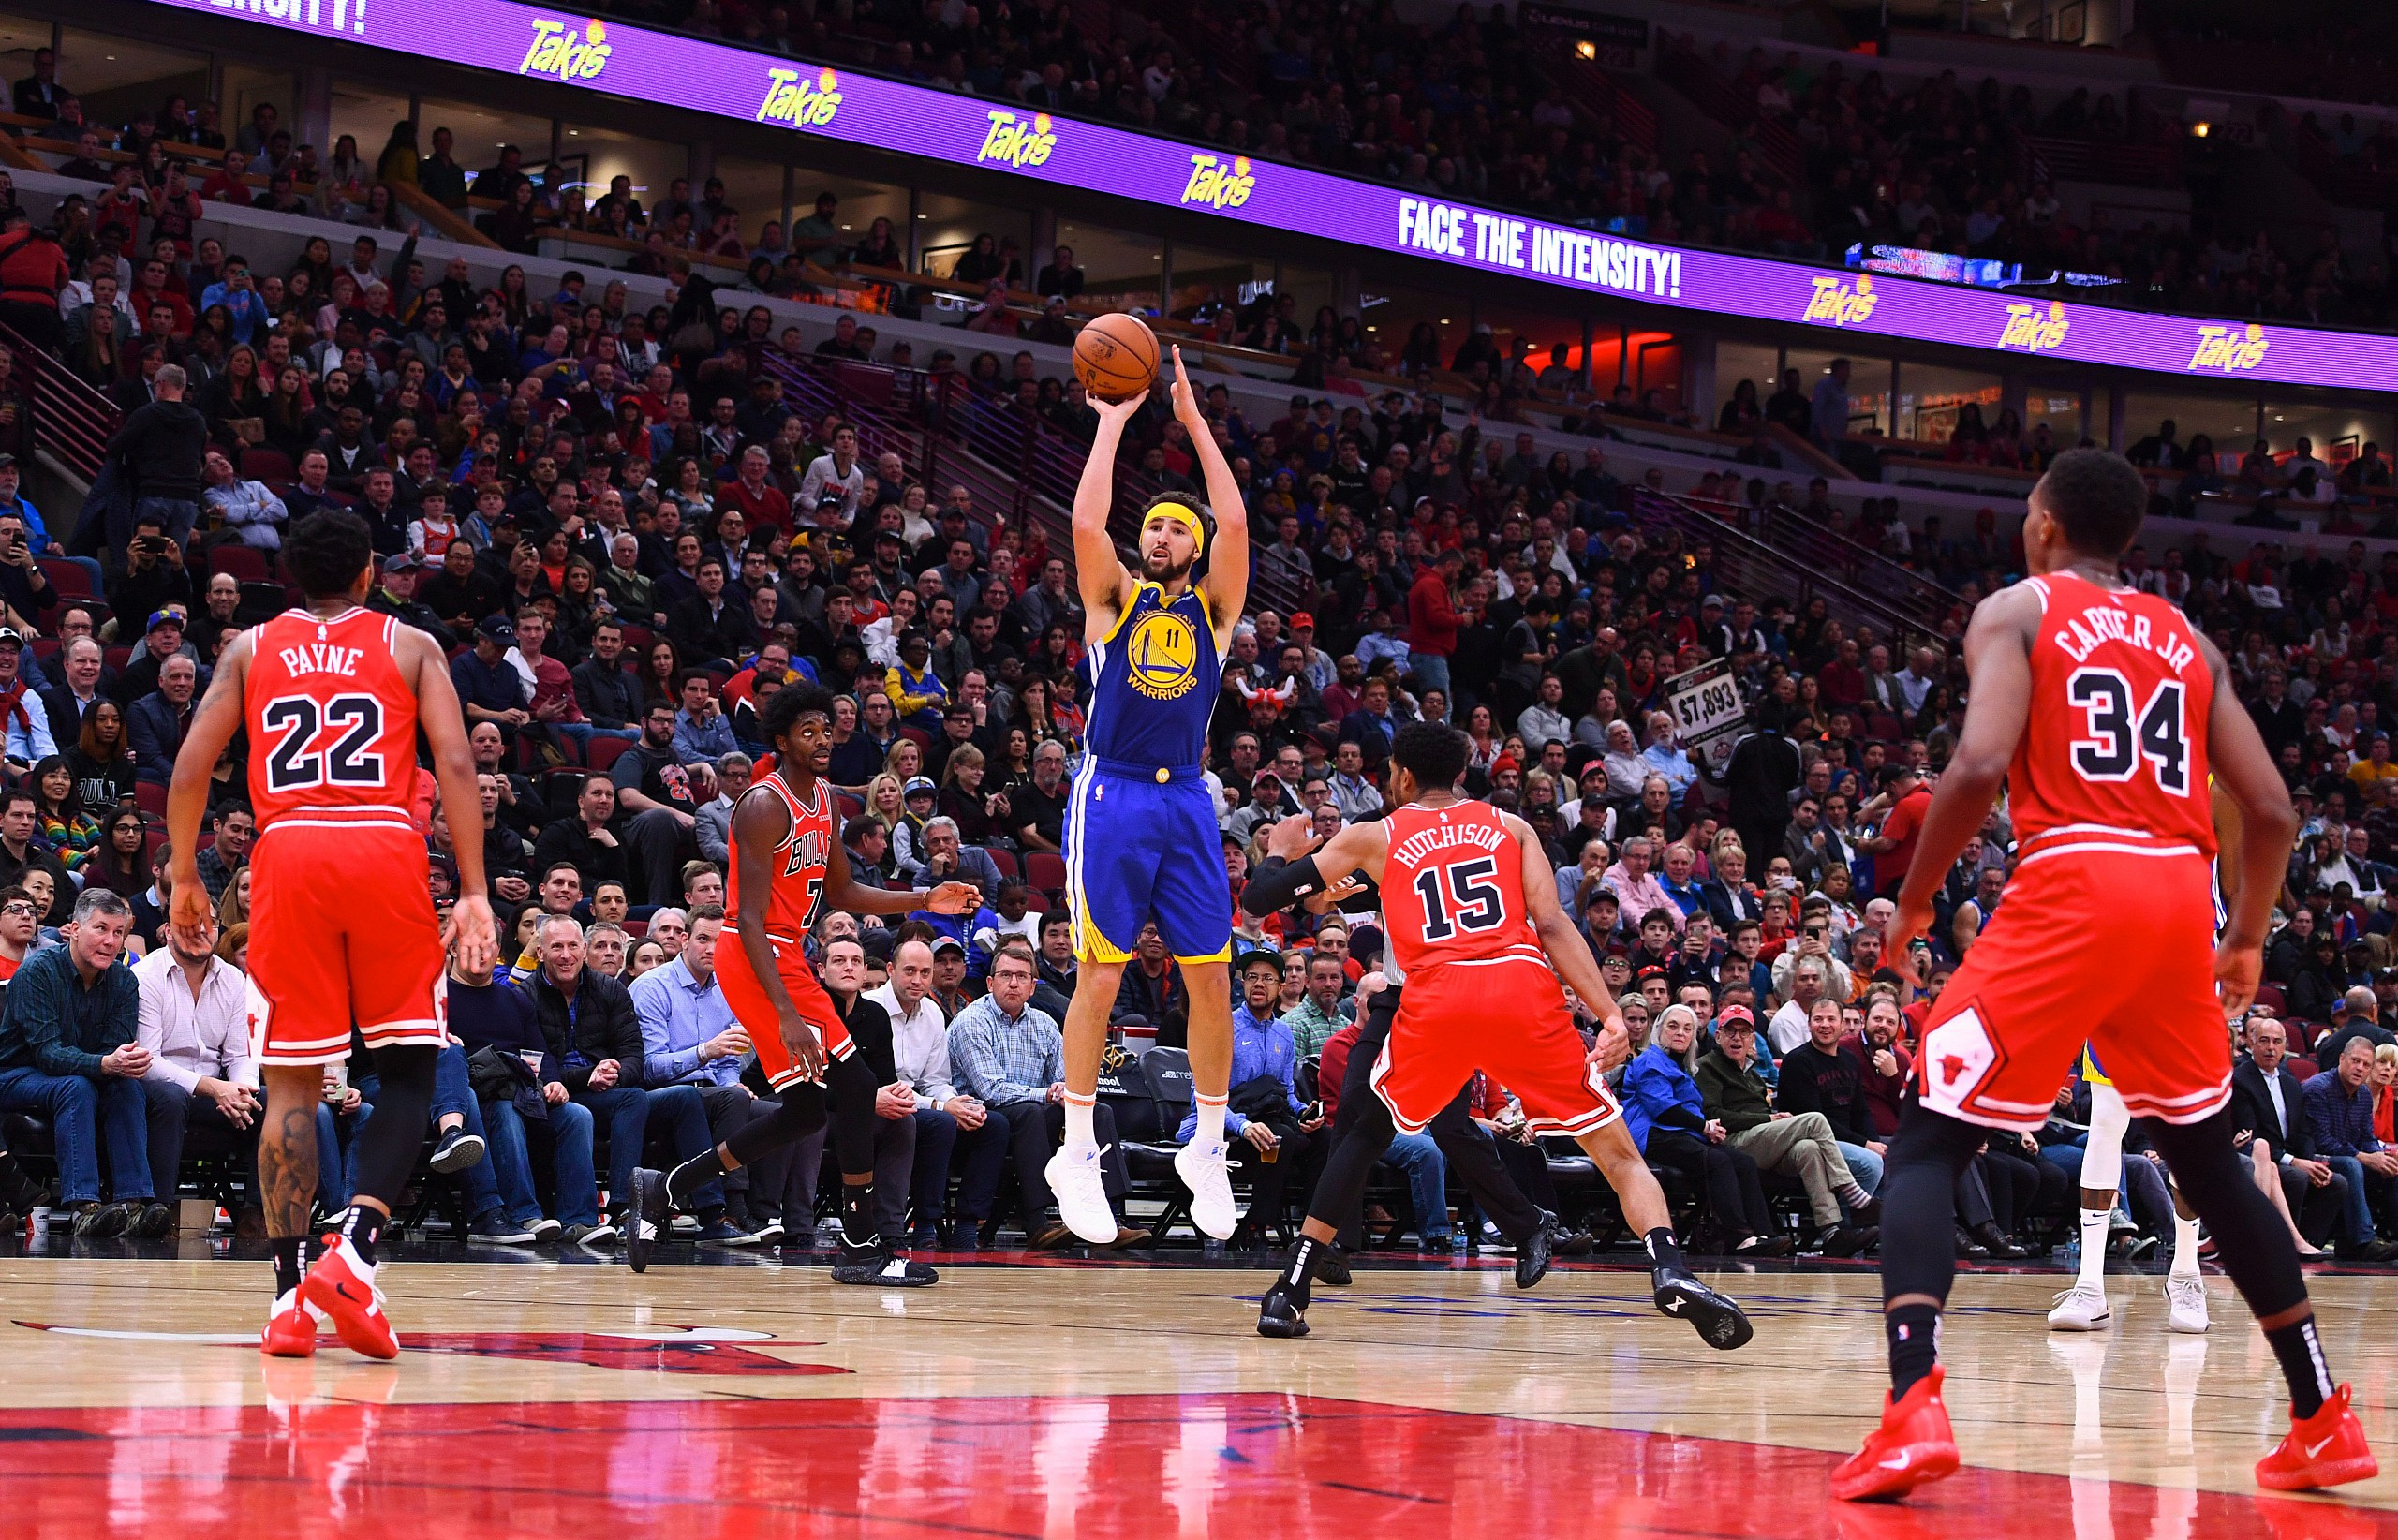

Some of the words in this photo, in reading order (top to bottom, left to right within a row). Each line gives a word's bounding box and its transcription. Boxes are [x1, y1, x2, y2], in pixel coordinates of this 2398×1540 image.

[519, 19, 612, 80] Takis
[756, 67, 843, 127] Takis
[977, 111, 1057, 168] Takis
[1181, 154, 1255, 210] Takis
[1399, 197, 1467, 257] FACE
[1473, 213, 1526, 269] THE
[1532, 226, 1681, 299] INTENSITY!
[1802, 274, 1877, 327] Takis
[1998, 301, 2070, 352] Takis
[2187, 323, 2270, 373] Takis
[279, 644, 363, 678] PAYNE
[1166, 629, 1179, 648] 11
[2054, 606, 2152, 663] CARTER
[2155, 631, 2195, 674] JR
[1127, 672, 1198, 700] WARRIORS
[1679, 682, 1735, 728] $7,893
[261, 692, 386, 794] 22
[2066, 666, 2191, 798] 34
[784, 830, 832, 877] BULL
[1393, 823, 1506, 870] HUTCHISON
[801, 877, 823, 929] 7
[1412, 854, 1506, 943] 15
[1097, 1075, 1120, 1087] hool
